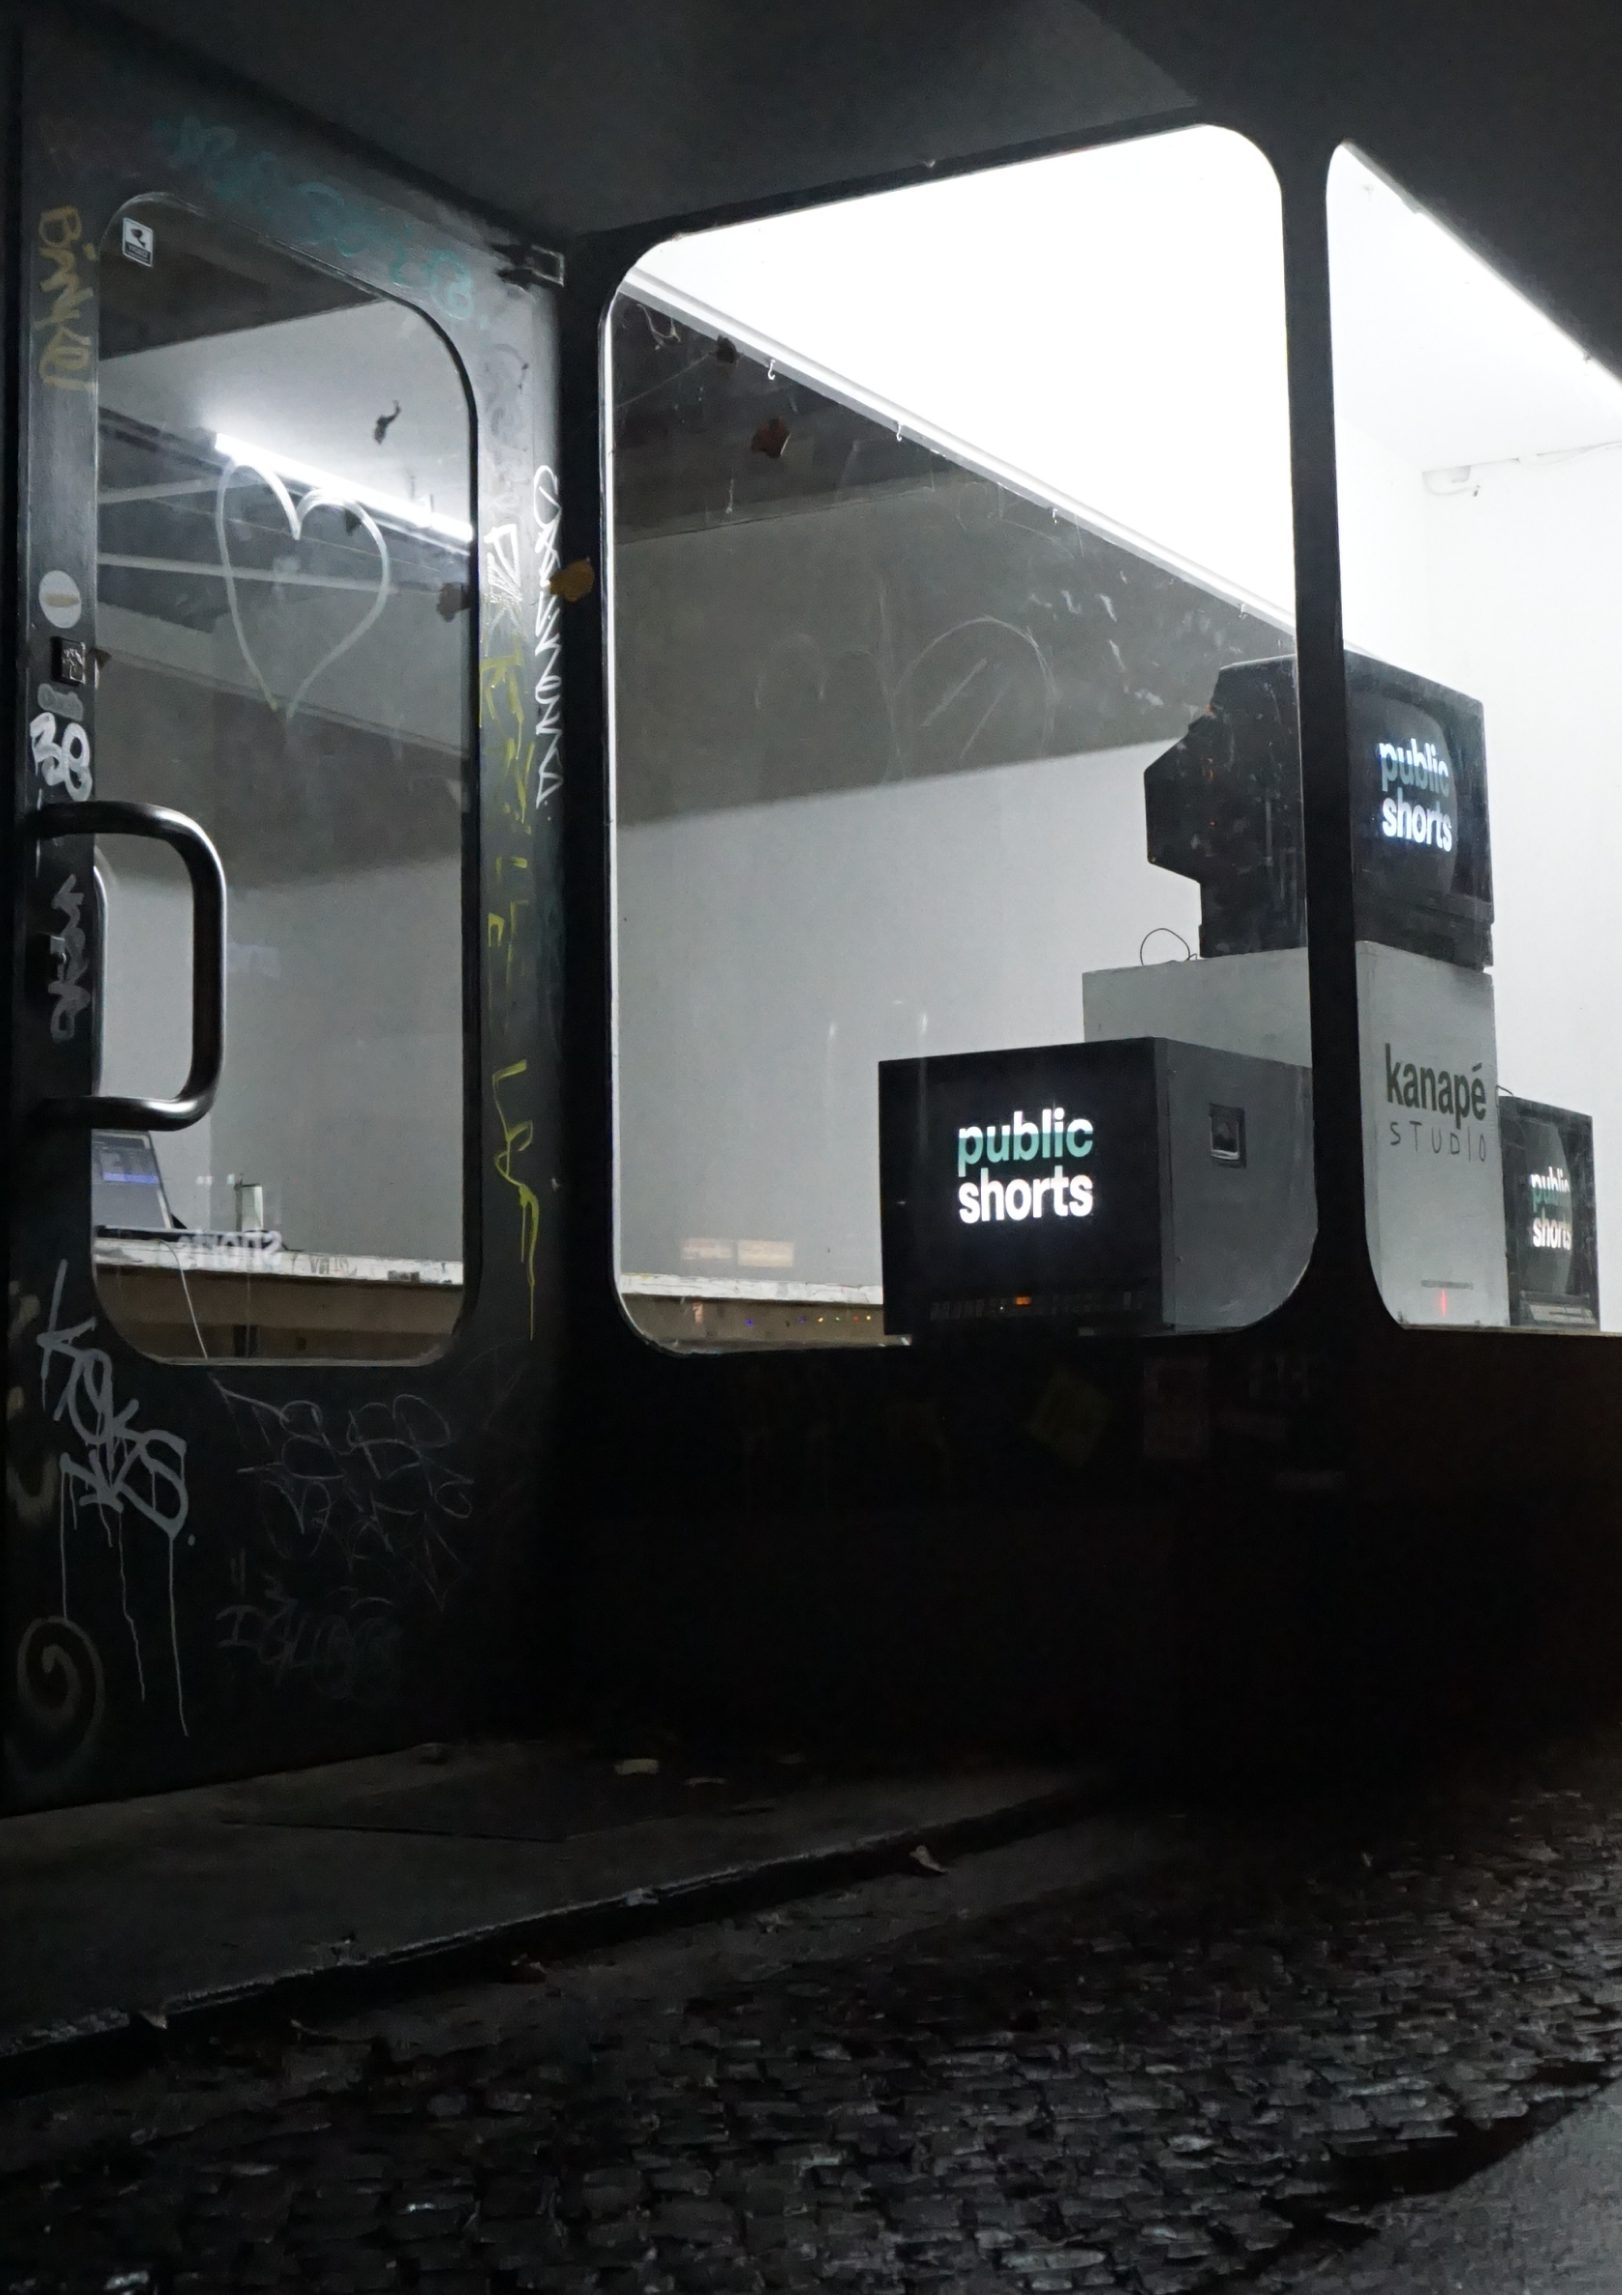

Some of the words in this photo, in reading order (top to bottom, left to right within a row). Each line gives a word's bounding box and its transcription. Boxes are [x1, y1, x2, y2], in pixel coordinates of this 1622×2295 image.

[1378, 738, 1451, 798] public
[1382, 787, 1452, 852] shorts
[1385, 1043, 1487, 1131] kanapé
[957, 1107, 1094, 1178] public
[1389, 1120, 1487, 1162] STUDIO
[958, 1165, 1094, 1224] shorts
[1532, 1207, 1572, 1251] shorts
